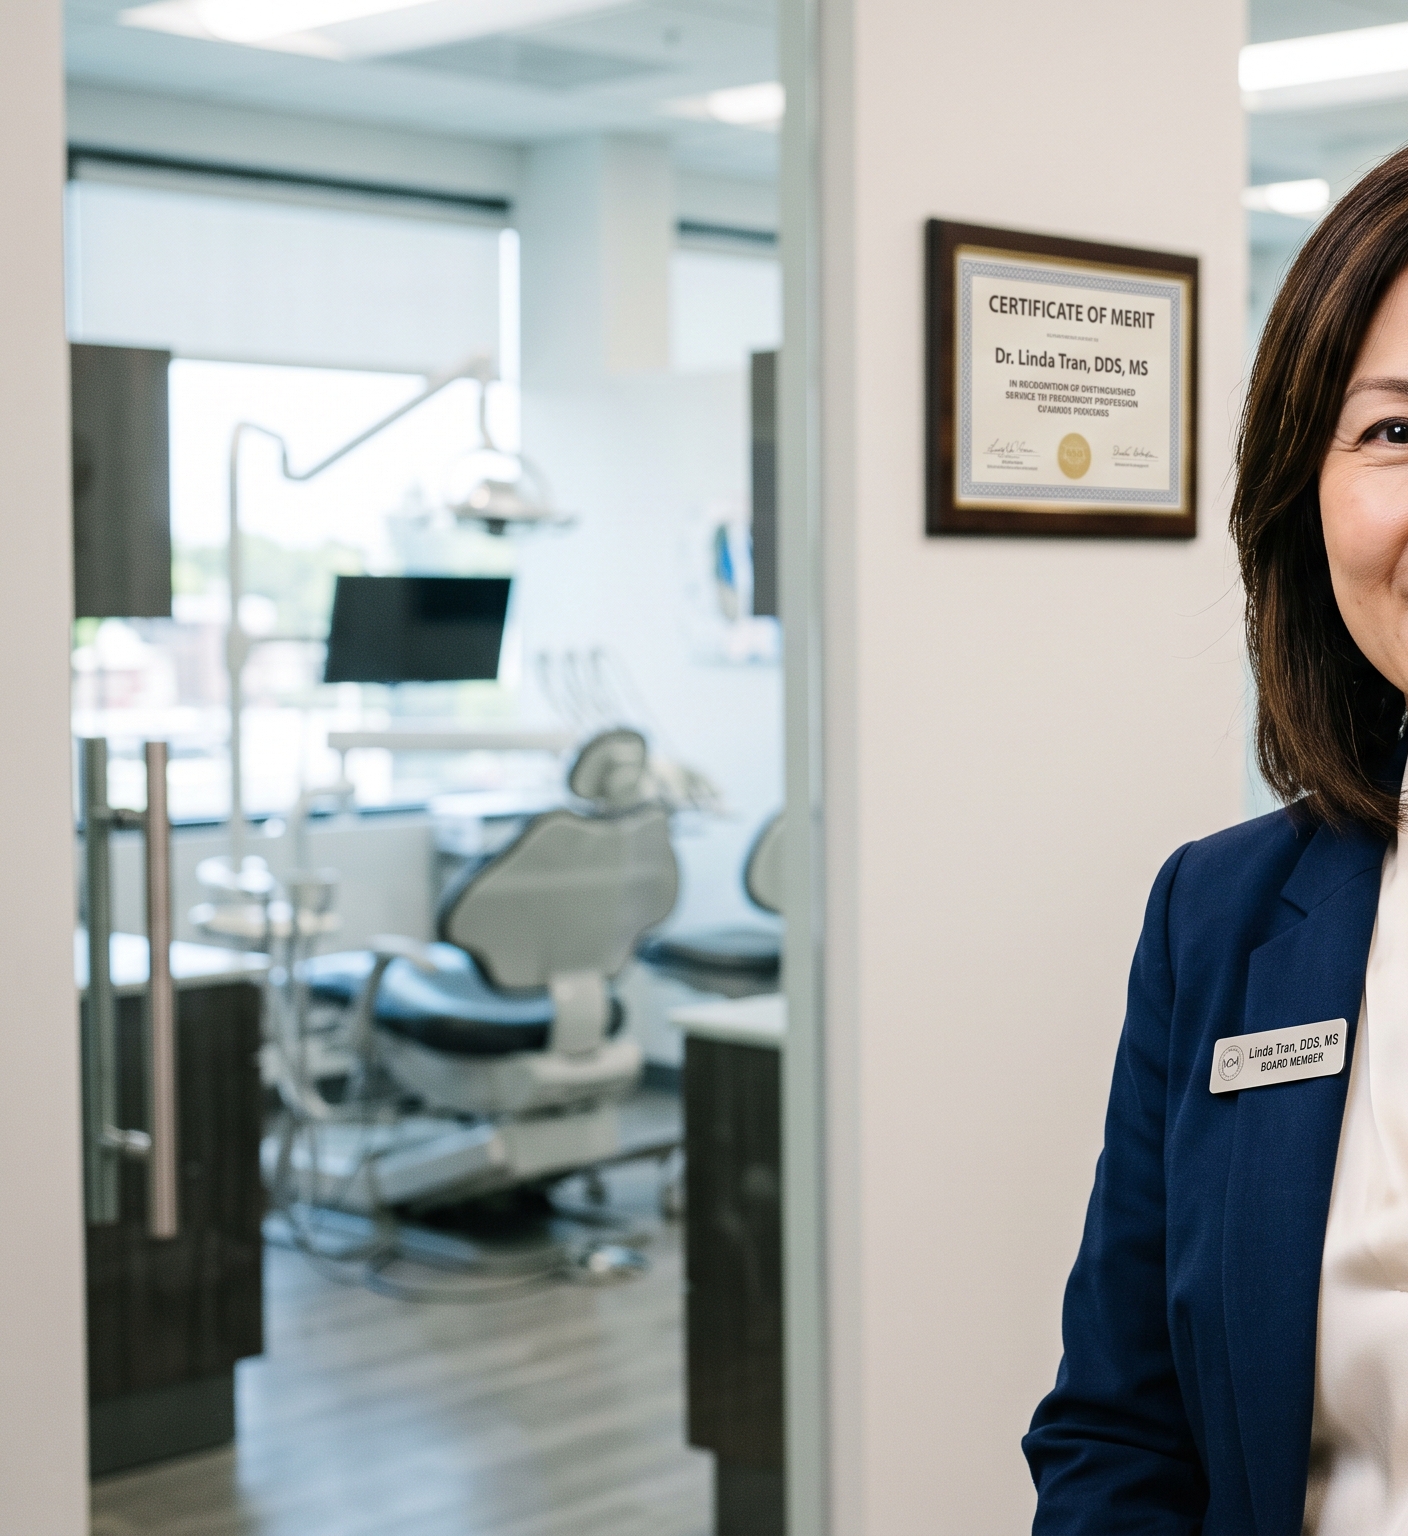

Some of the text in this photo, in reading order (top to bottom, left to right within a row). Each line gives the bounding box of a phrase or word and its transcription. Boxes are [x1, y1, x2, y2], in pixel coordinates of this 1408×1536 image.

[989, 295, 1155, 329] CERTIFICATE OF MERIT
[995, 347, 1148, 377] Dr. Linda Tran, DDS, MS
[1009, 379, 1017, 388] IN
[1249, 1045, 1273, 1059] Linda
[1276, 1042, 1297, 1054] Tran,
[1324, 1033, 1339, 1046] MS
[1260, 1052, 1324, 1072] BOARD MEMBER
